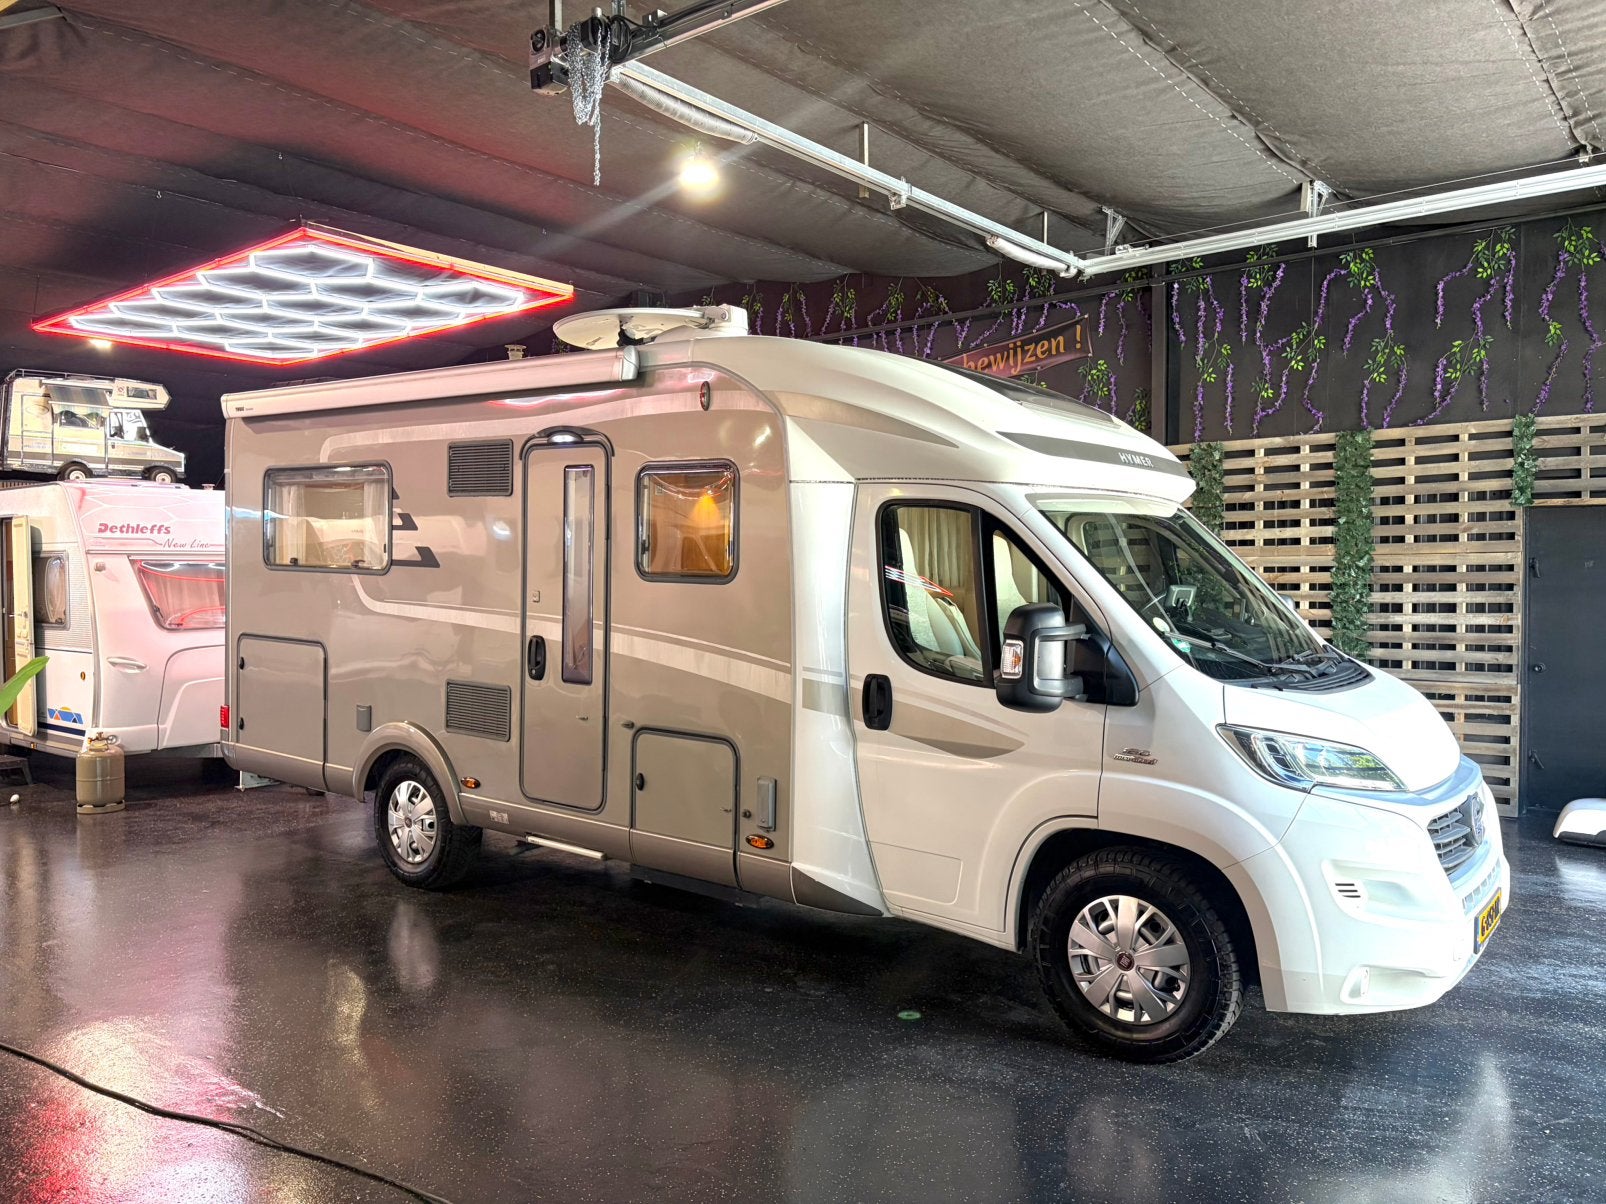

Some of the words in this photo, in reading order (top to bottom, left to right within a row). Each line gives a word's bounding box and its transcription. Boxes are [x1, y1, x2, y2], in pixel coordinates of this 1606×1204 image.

[1075, 324, 1082, 350] !
[1118, 452, 1154, 468] HYMER
[97, 522, 171, 535] Dethleffs
[163, 538, 187, 549] New
[190, 538, 210, 549] Line
